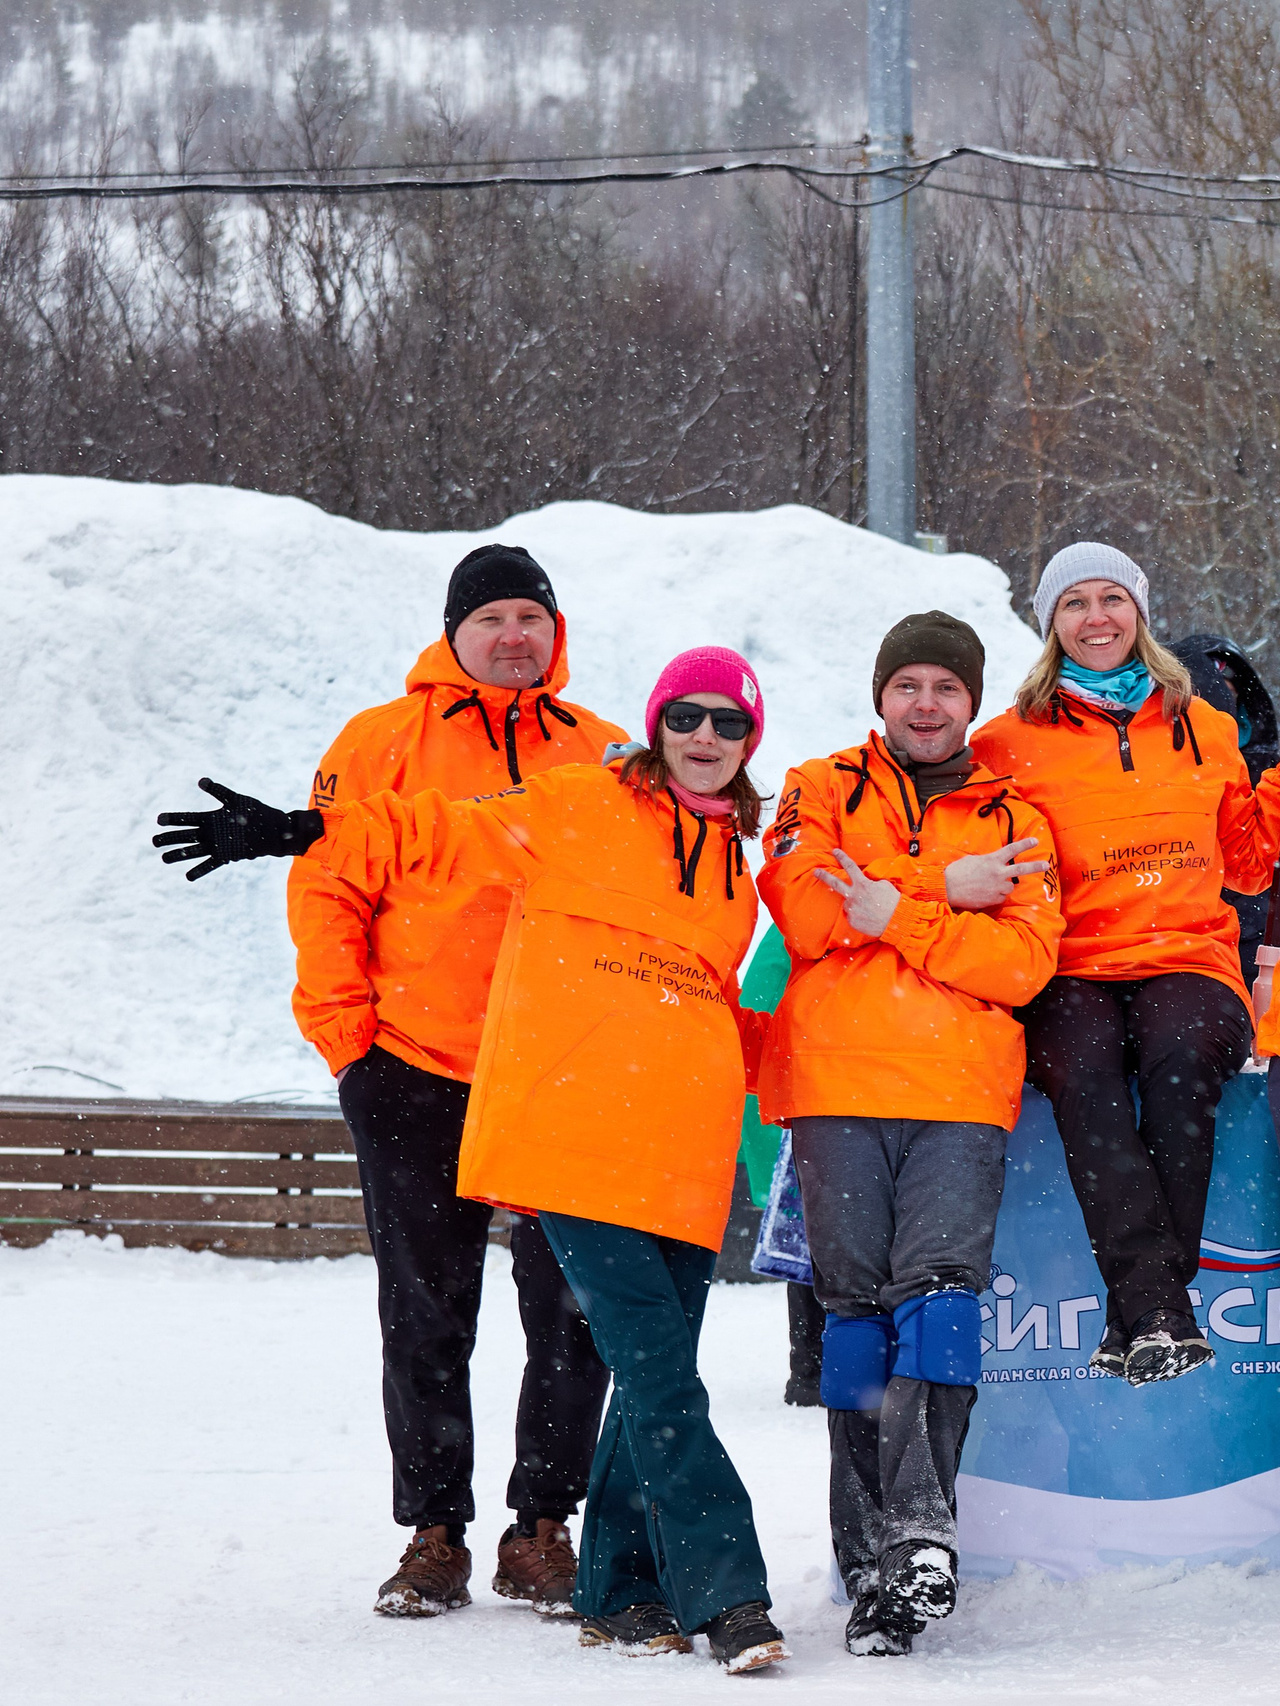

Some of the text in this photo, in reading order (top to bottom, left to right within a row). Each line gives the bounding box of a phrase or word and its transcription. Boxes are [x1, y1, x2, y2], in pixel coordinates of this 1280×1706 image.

[1103, 840, 1196, 862] НИКОГДА
[1081, 856, 1211, 882] НЕ ЗАМЕРЗАЕМ
[594, 958, 624, 974] НО
[628, 966, 651, 983] НЕ
[638, 951, 710, 985] ГРУЗИМ,
